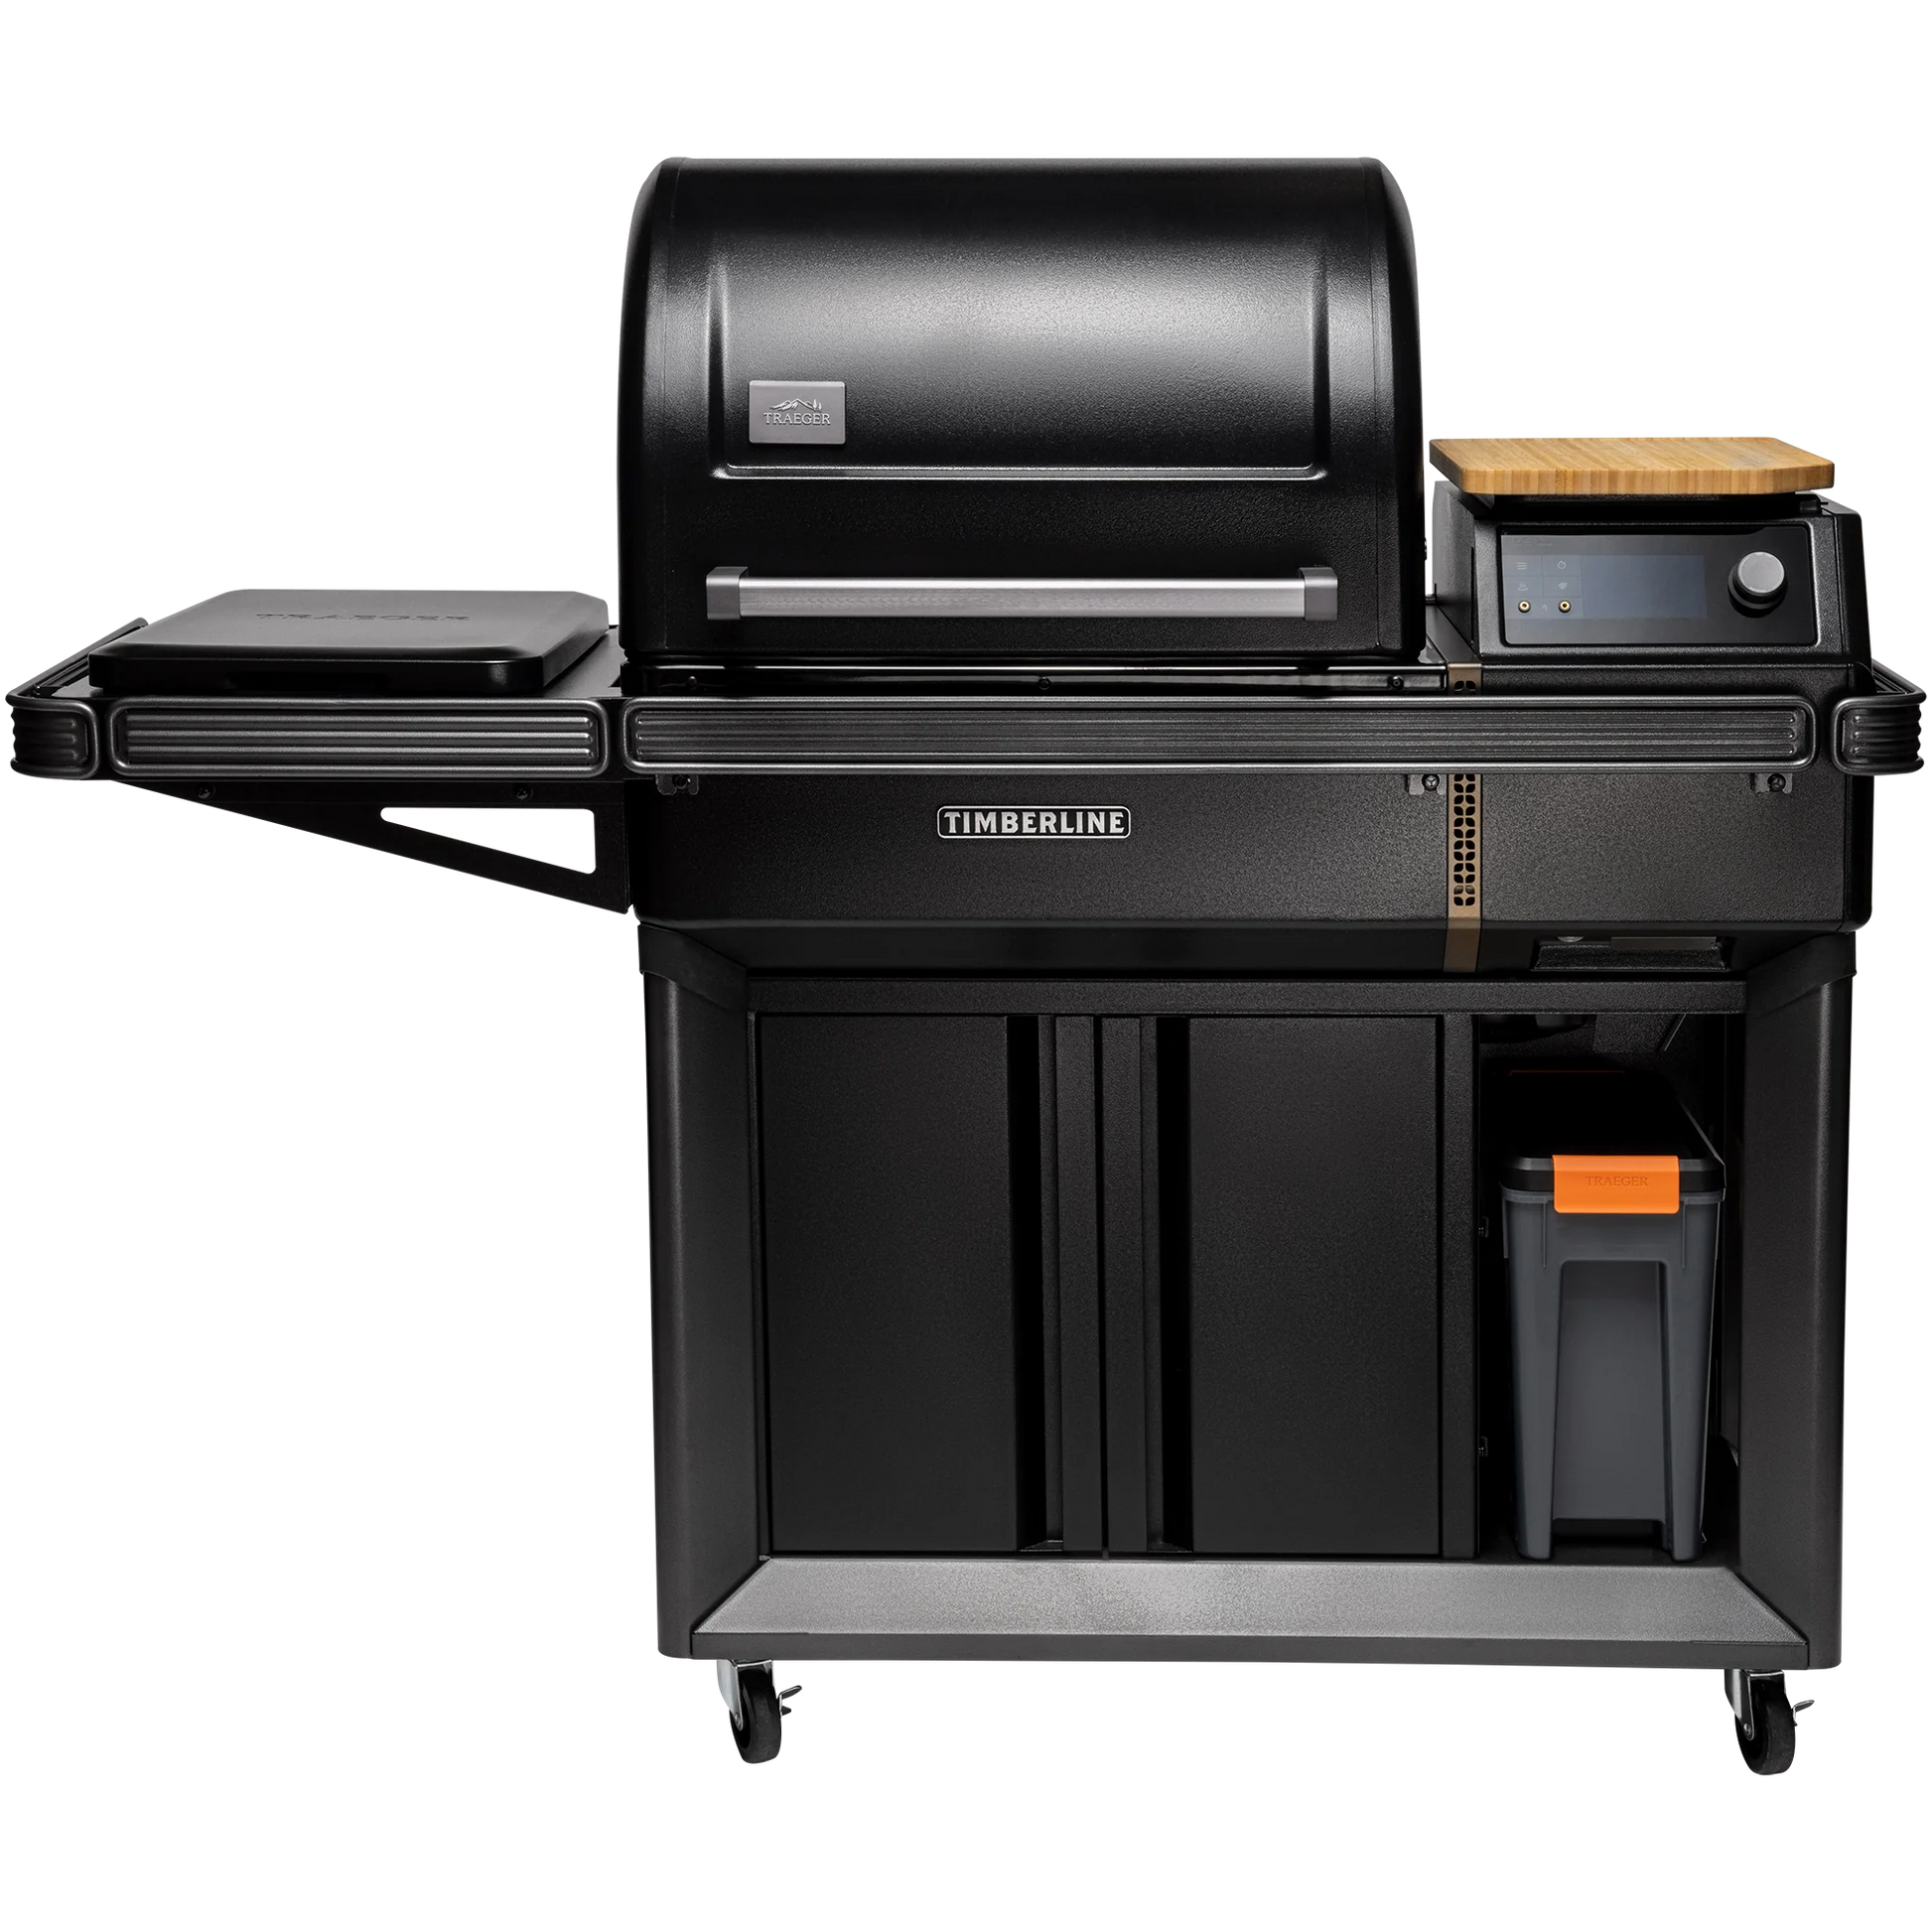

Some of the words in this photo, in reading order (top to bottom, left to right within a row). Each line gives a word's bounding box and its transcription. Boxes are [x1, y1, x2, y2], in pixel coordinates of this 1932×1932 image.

[763, 412, 831, 425] TRAEGER
[944, 811, 1125, 834] TIMBERLINE
[1586, 1175, 1649, 1186] TRAEGER
